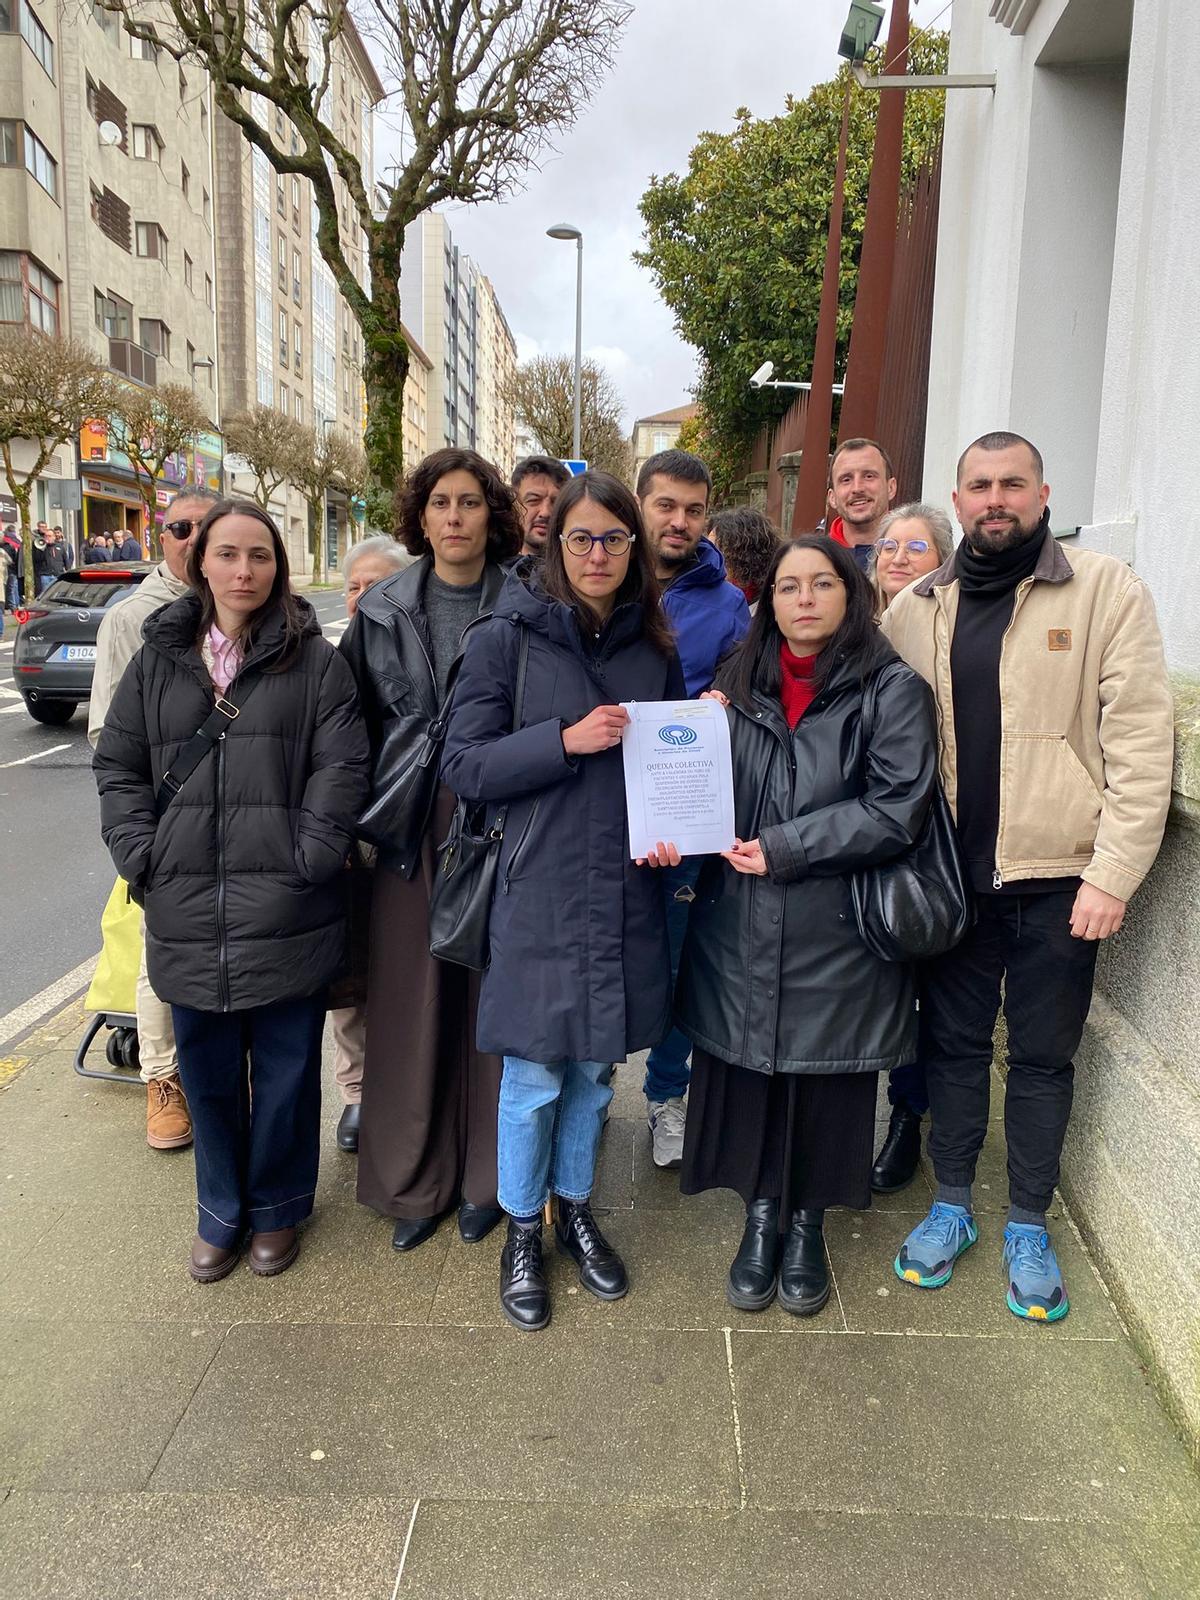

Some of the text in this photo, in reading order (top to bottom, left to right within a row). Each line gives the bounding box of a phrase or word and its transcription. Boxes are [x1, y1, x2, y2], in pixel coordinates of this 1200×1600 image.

[69, 647, 94, 658] 9104
[646, 760, 714, 771] QUEIXA COLECTIVA
